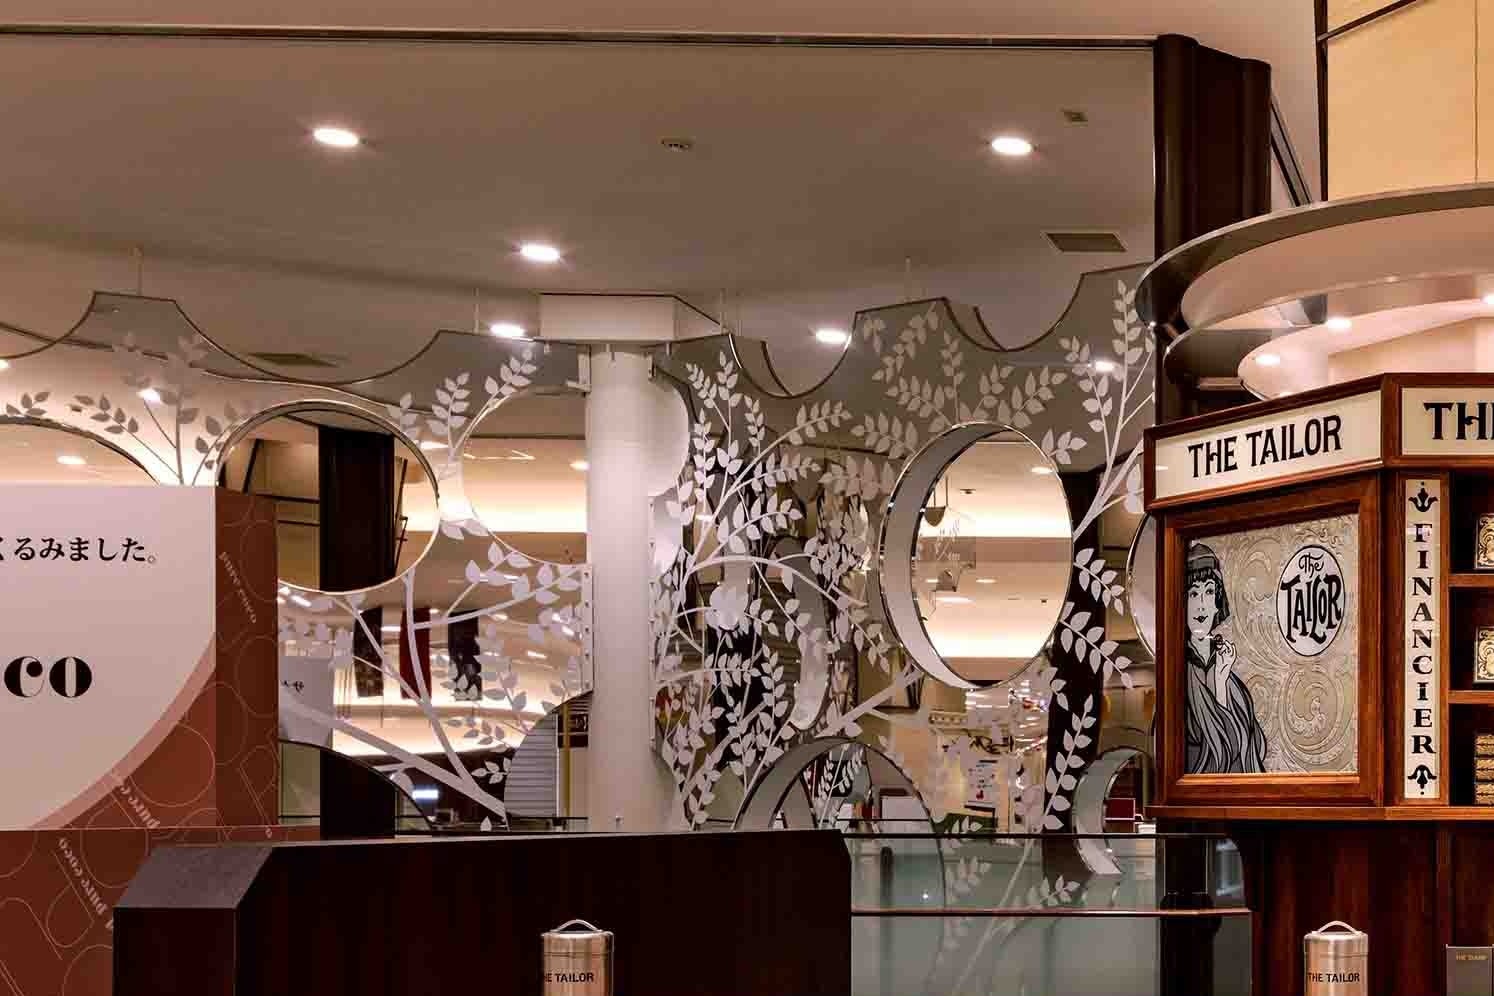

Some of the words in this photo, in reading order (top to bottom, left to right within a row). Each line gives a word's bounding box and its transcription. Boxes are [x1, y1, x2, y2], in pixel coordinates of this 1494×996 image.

[1188, 435, 1238, 478] THE
[1246, 414, 1342, 467] TAILOR
[1298, 552, 1325, 579] The
[1280, 573, 1342, 644] TAILOR
[1411, 522, 1437, 754] FINANCIER
[555, 972, 594, 983] TAILOR
[1308, 972, 1322, 983] THE
[1326, 972, 1360, 983] TAILOR
